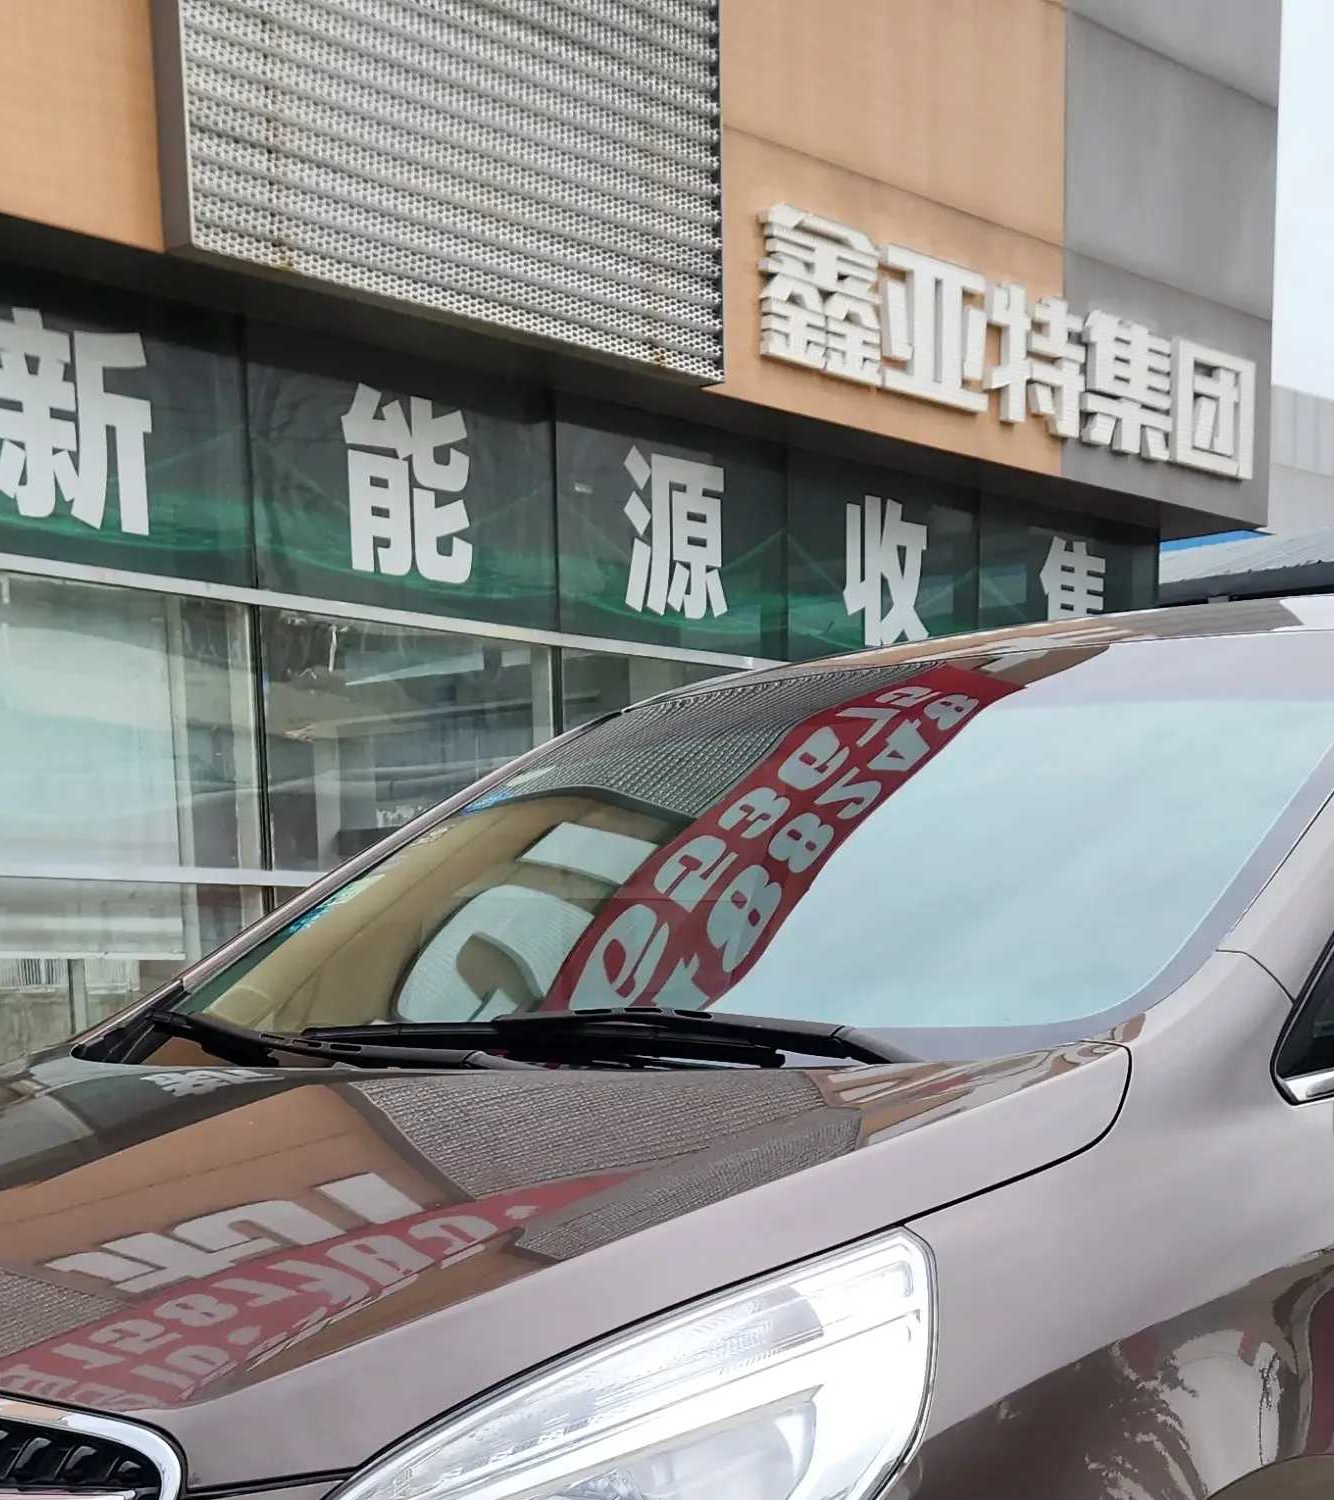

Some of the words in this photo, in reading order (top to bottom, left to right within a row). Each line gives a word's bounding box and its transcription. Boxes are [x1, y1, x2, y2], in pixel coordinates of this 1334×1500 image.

[757, 202, 1257, 480] 鑫亚特集团
